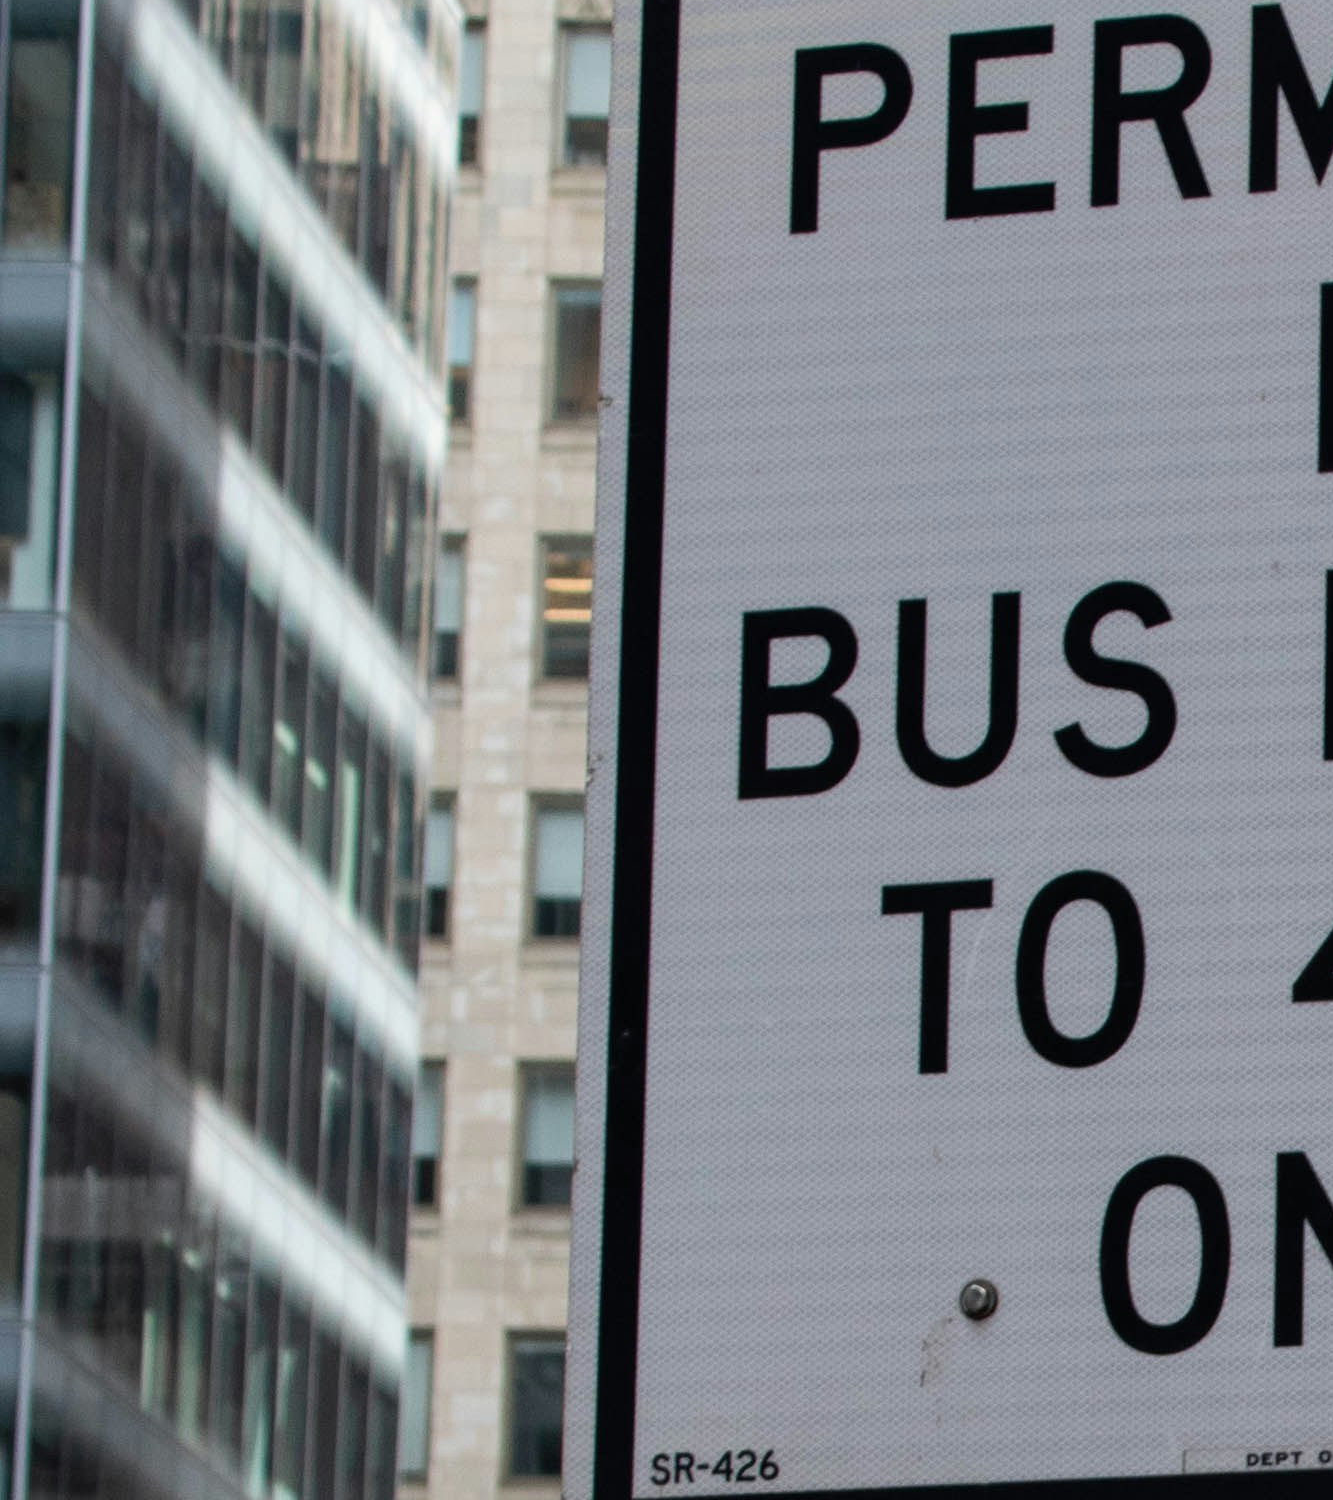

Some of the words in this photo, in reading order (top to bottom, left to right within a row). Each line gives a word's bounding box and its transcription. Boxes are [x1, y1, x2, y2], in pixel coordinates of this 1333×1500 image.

[736, 579, 1179, 802] BUS
[879, 868, 1147, 1076] TO
[650, 1449, 781, 1486] SR-426
[1245, 1450, 1303, 1468] DEPT
